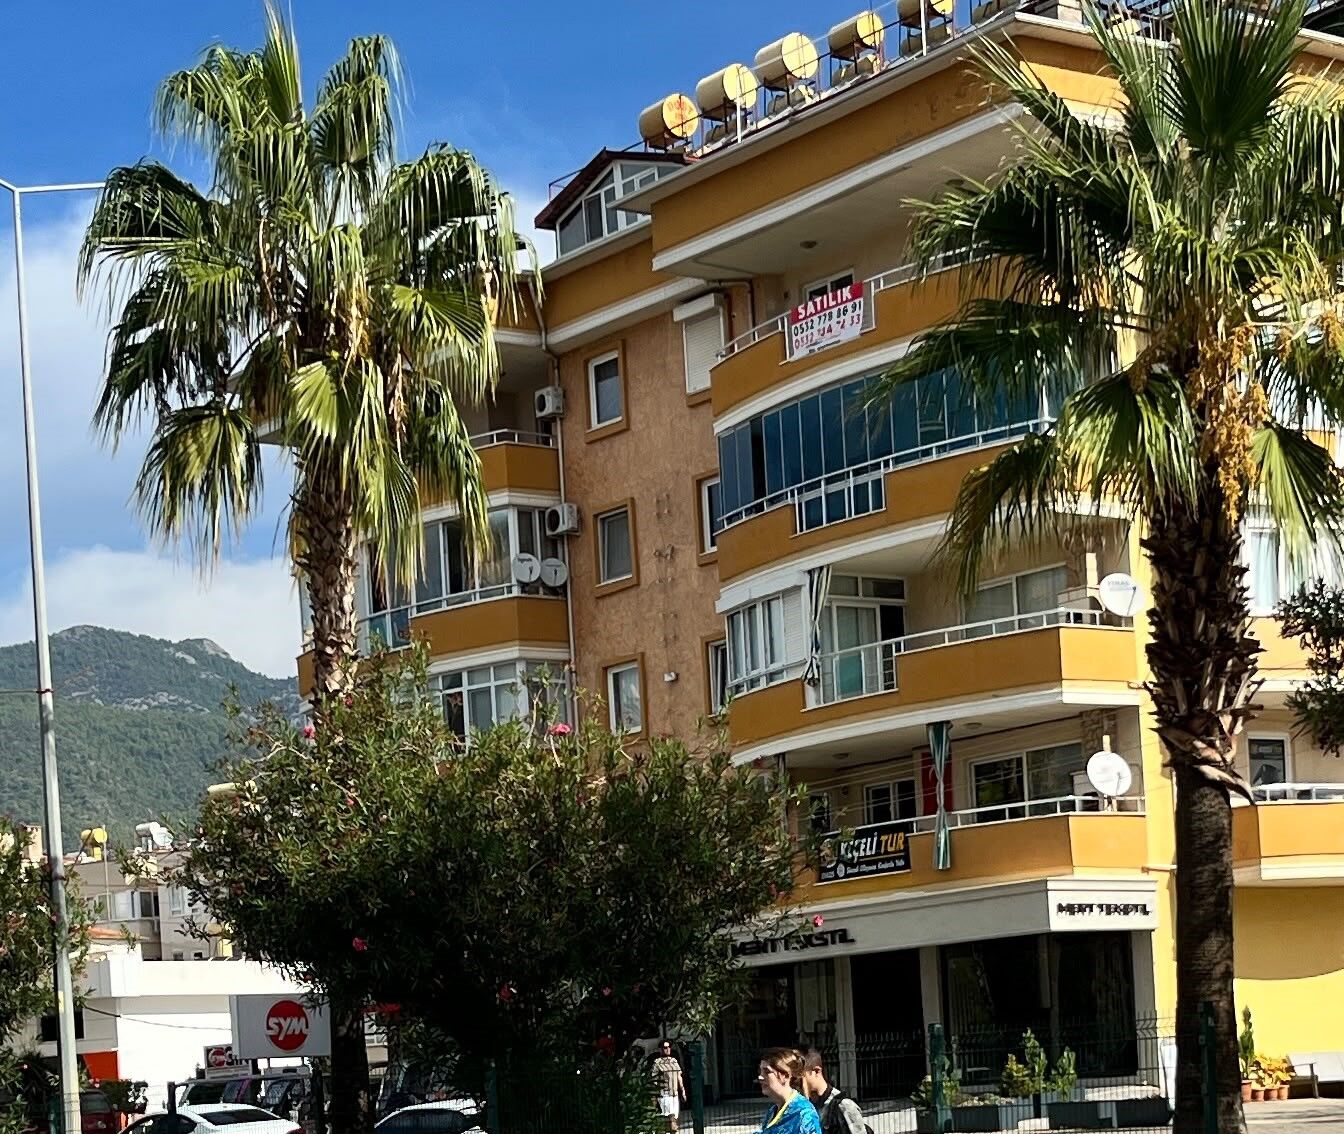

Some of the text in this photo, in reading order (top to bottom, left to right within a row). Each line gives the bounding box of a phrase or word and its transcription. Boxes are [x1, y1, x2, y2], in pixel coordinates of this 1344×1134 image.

[797, 285, 852, 320] SATILIK
[880, 832, 905, 855] TUR
[266, 1015, 309, 1041] SYM
